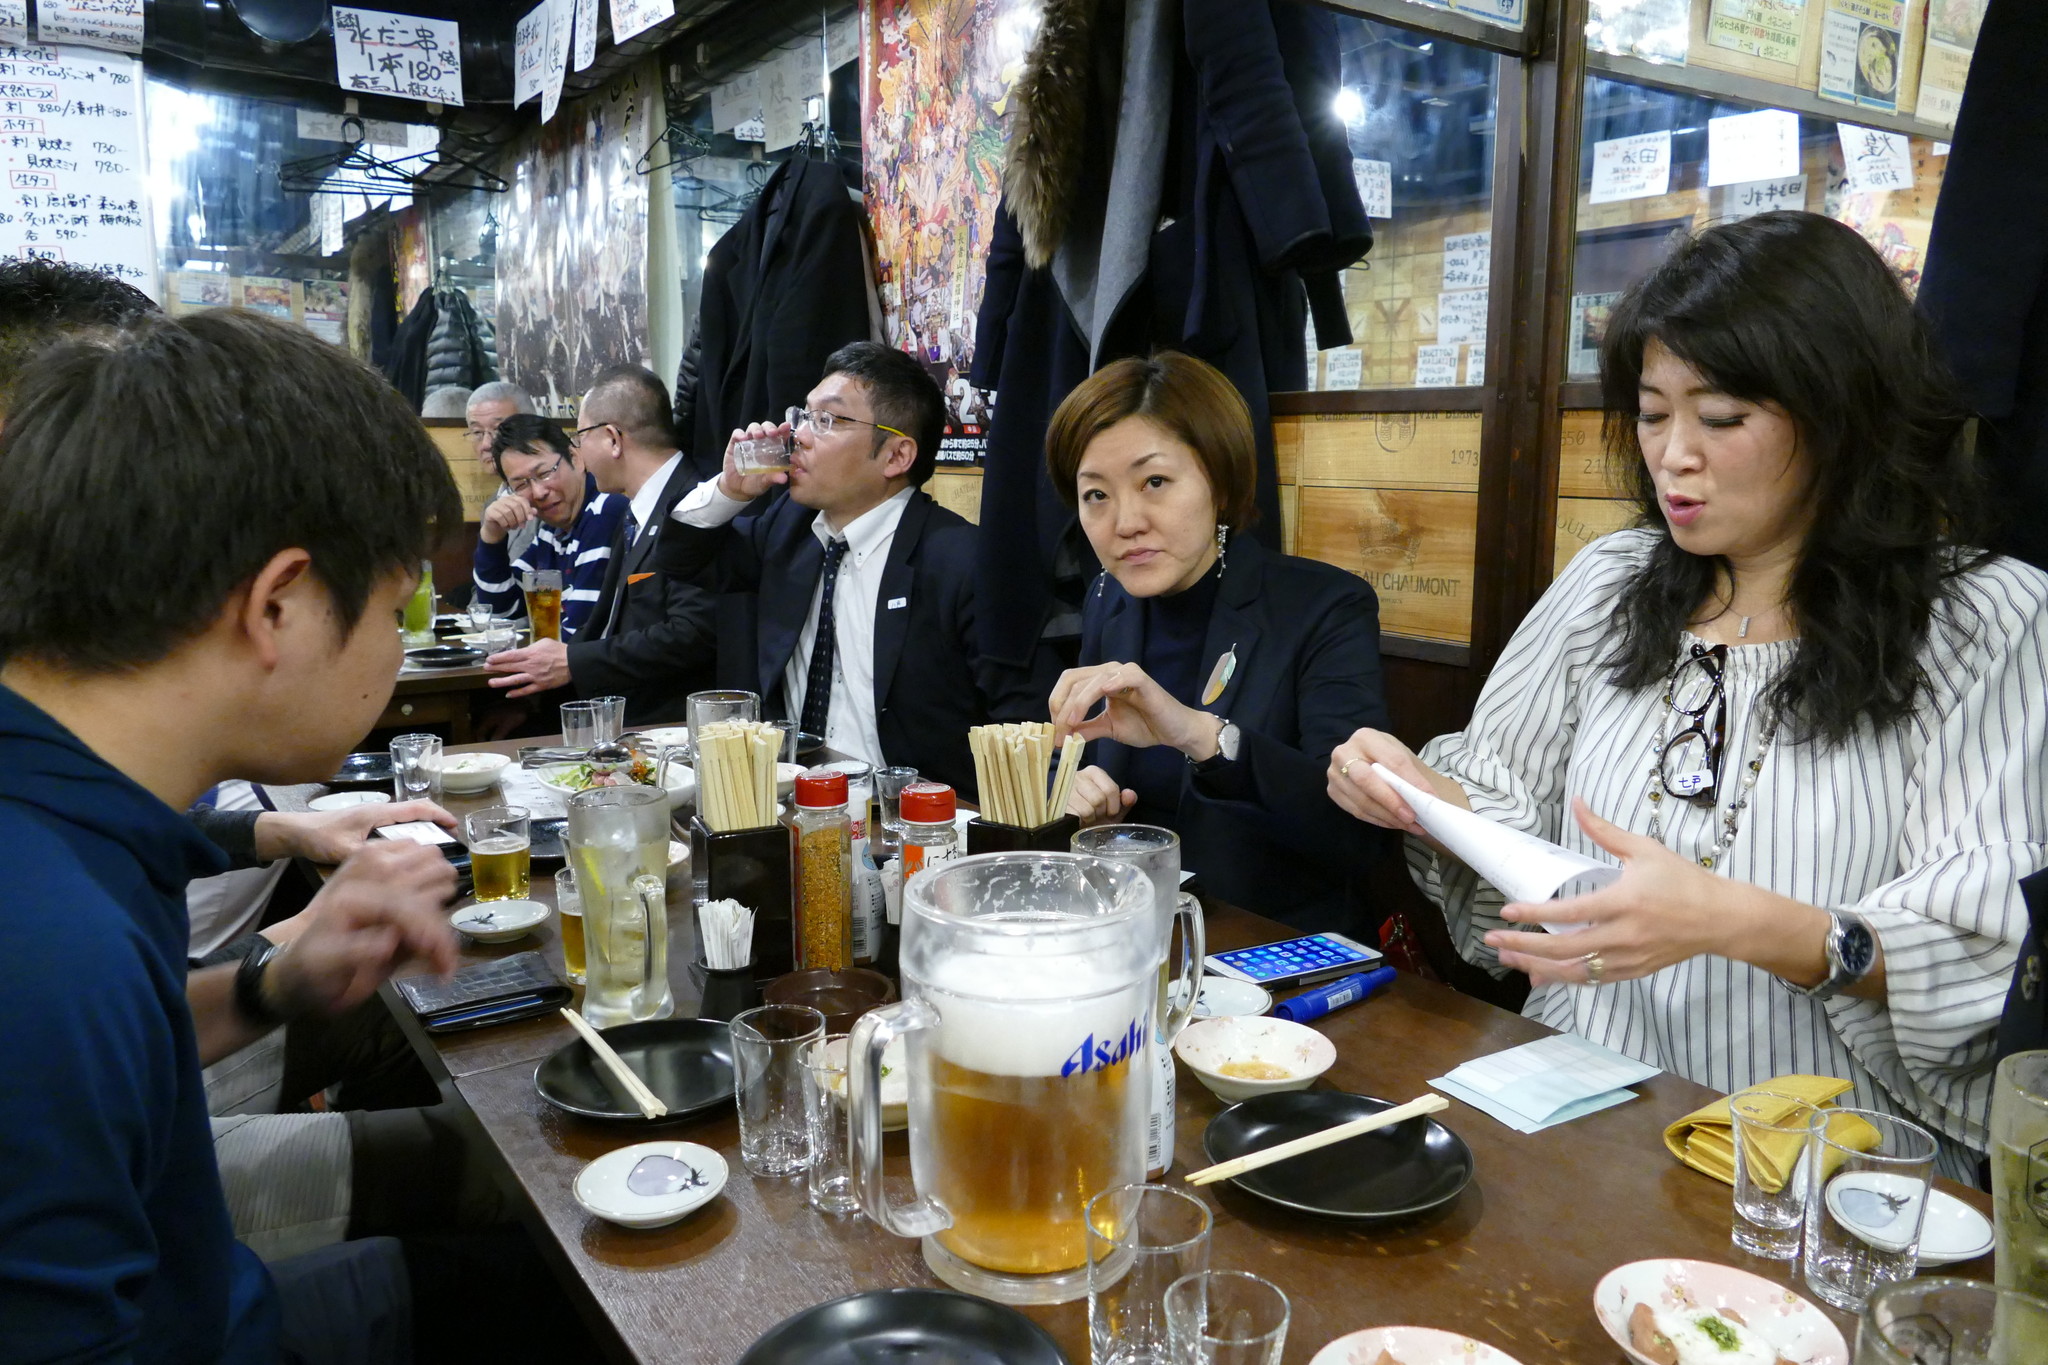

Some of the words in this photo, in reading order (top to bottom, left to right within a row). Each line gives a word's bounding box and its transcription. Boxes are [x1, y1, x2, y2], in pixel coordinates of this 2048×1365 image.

[3, 119, 35, 131] ホタテ
[16, 173, 48, 187] 生タコ
[1451, 449, 1479, 467] 1973
[1382, 572, 1461, 598] CHAUMONT
